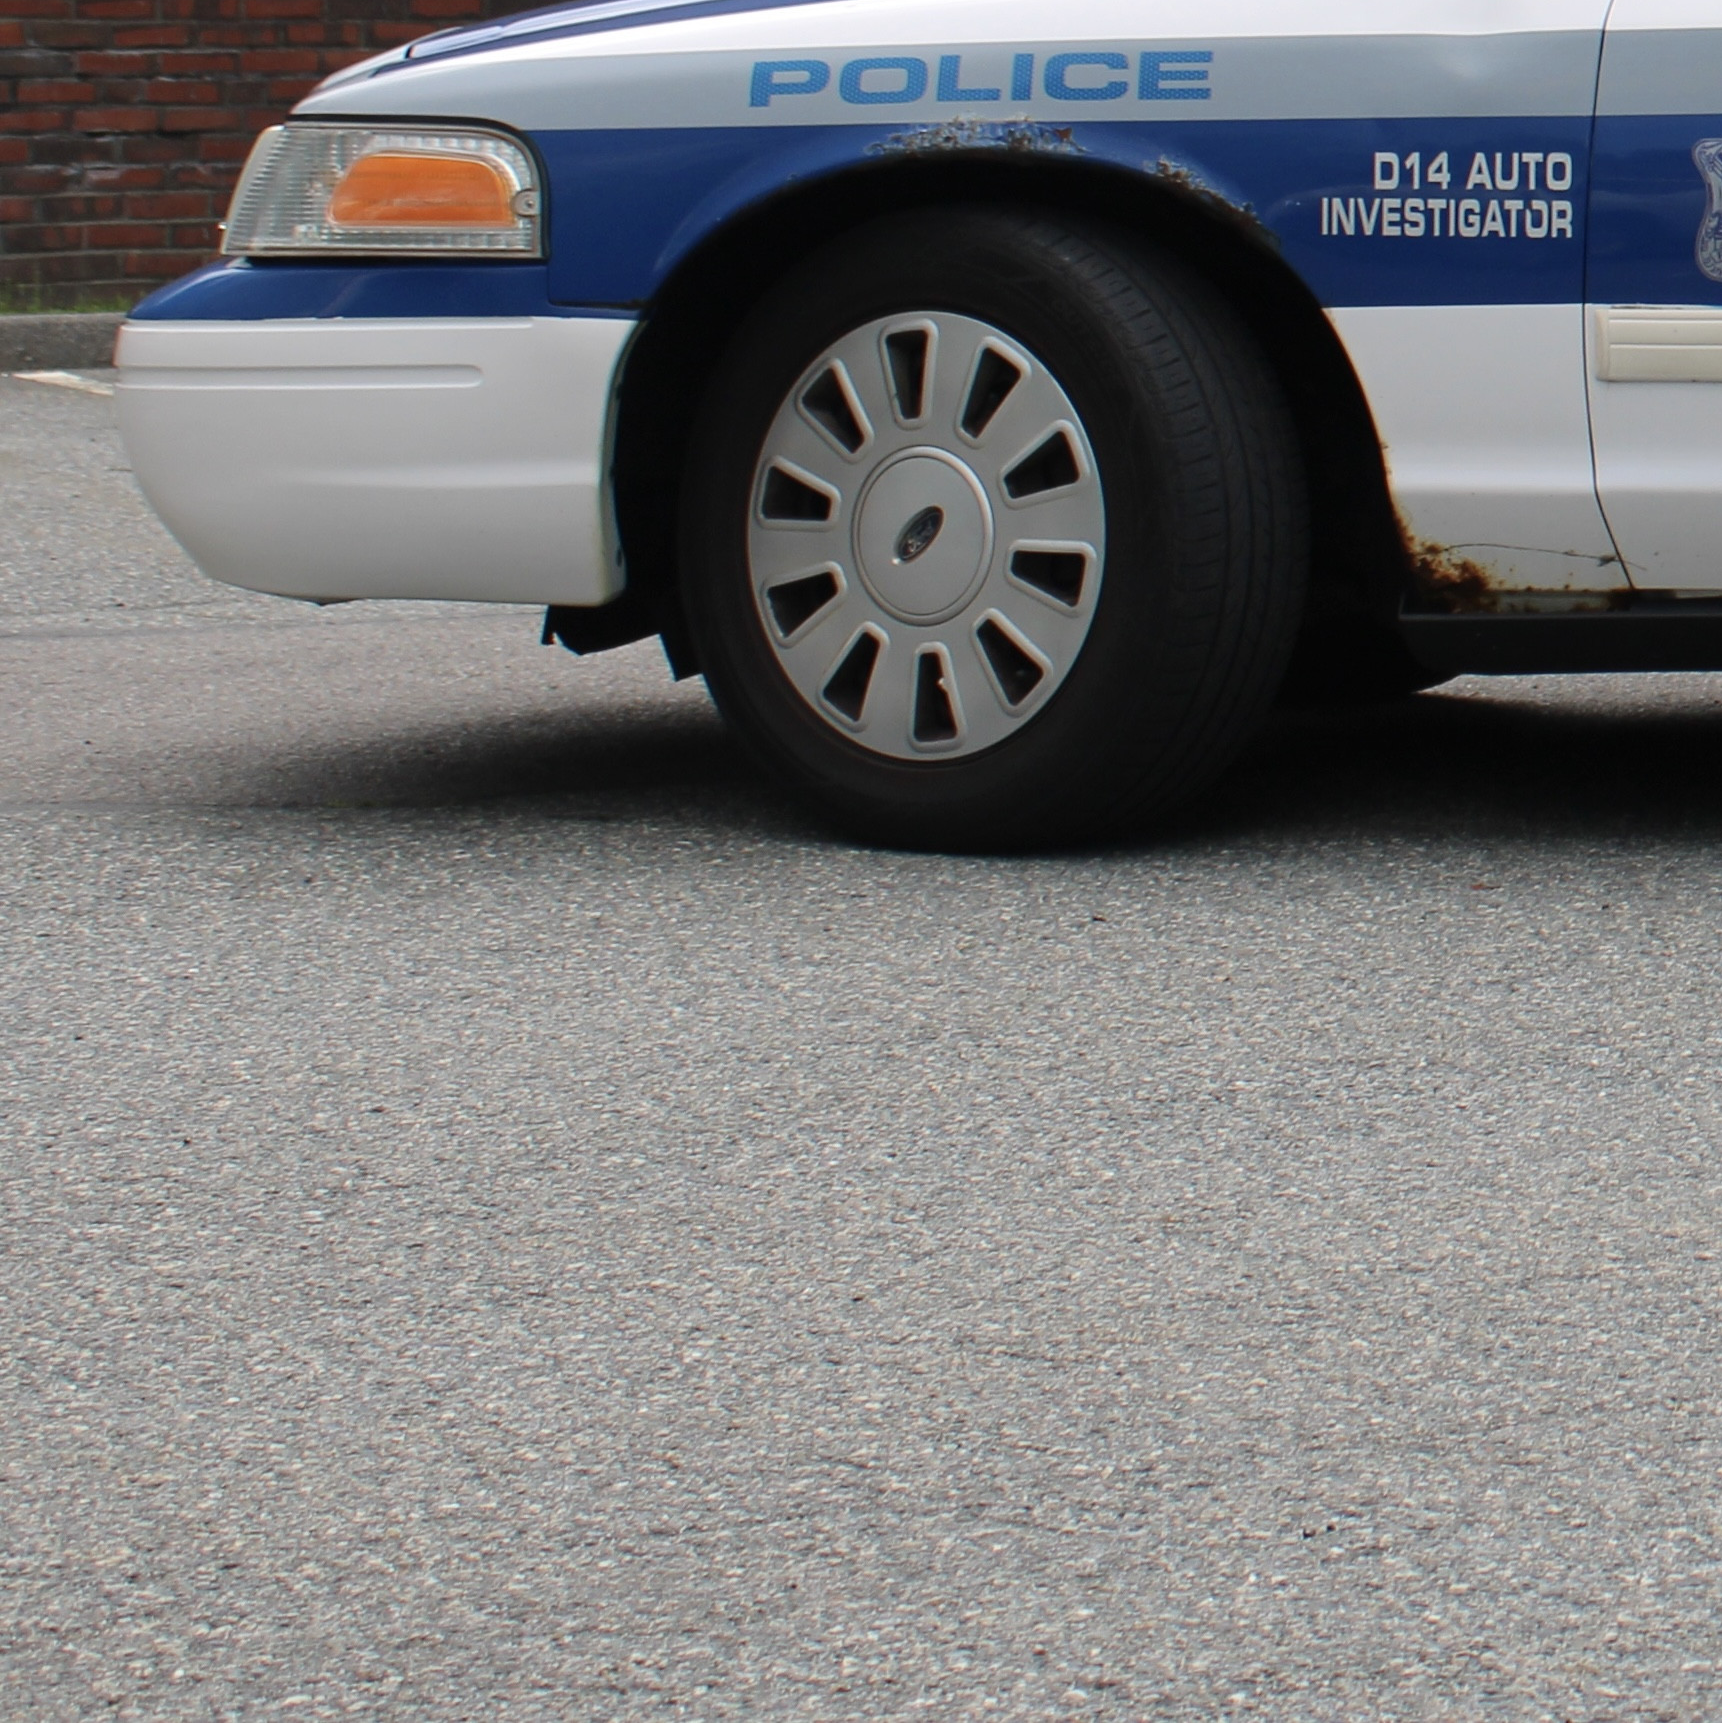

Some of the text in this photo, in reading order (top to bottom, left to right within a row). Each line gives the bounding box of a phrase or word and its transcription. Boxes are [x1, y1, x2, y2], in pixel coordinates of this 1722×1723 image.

[749, 51, 1213, 107] POLICE
[1373, 151, 1572, 191] D14 AUTO
[1321, 197, 1572, 238] INVESTIGATOR
